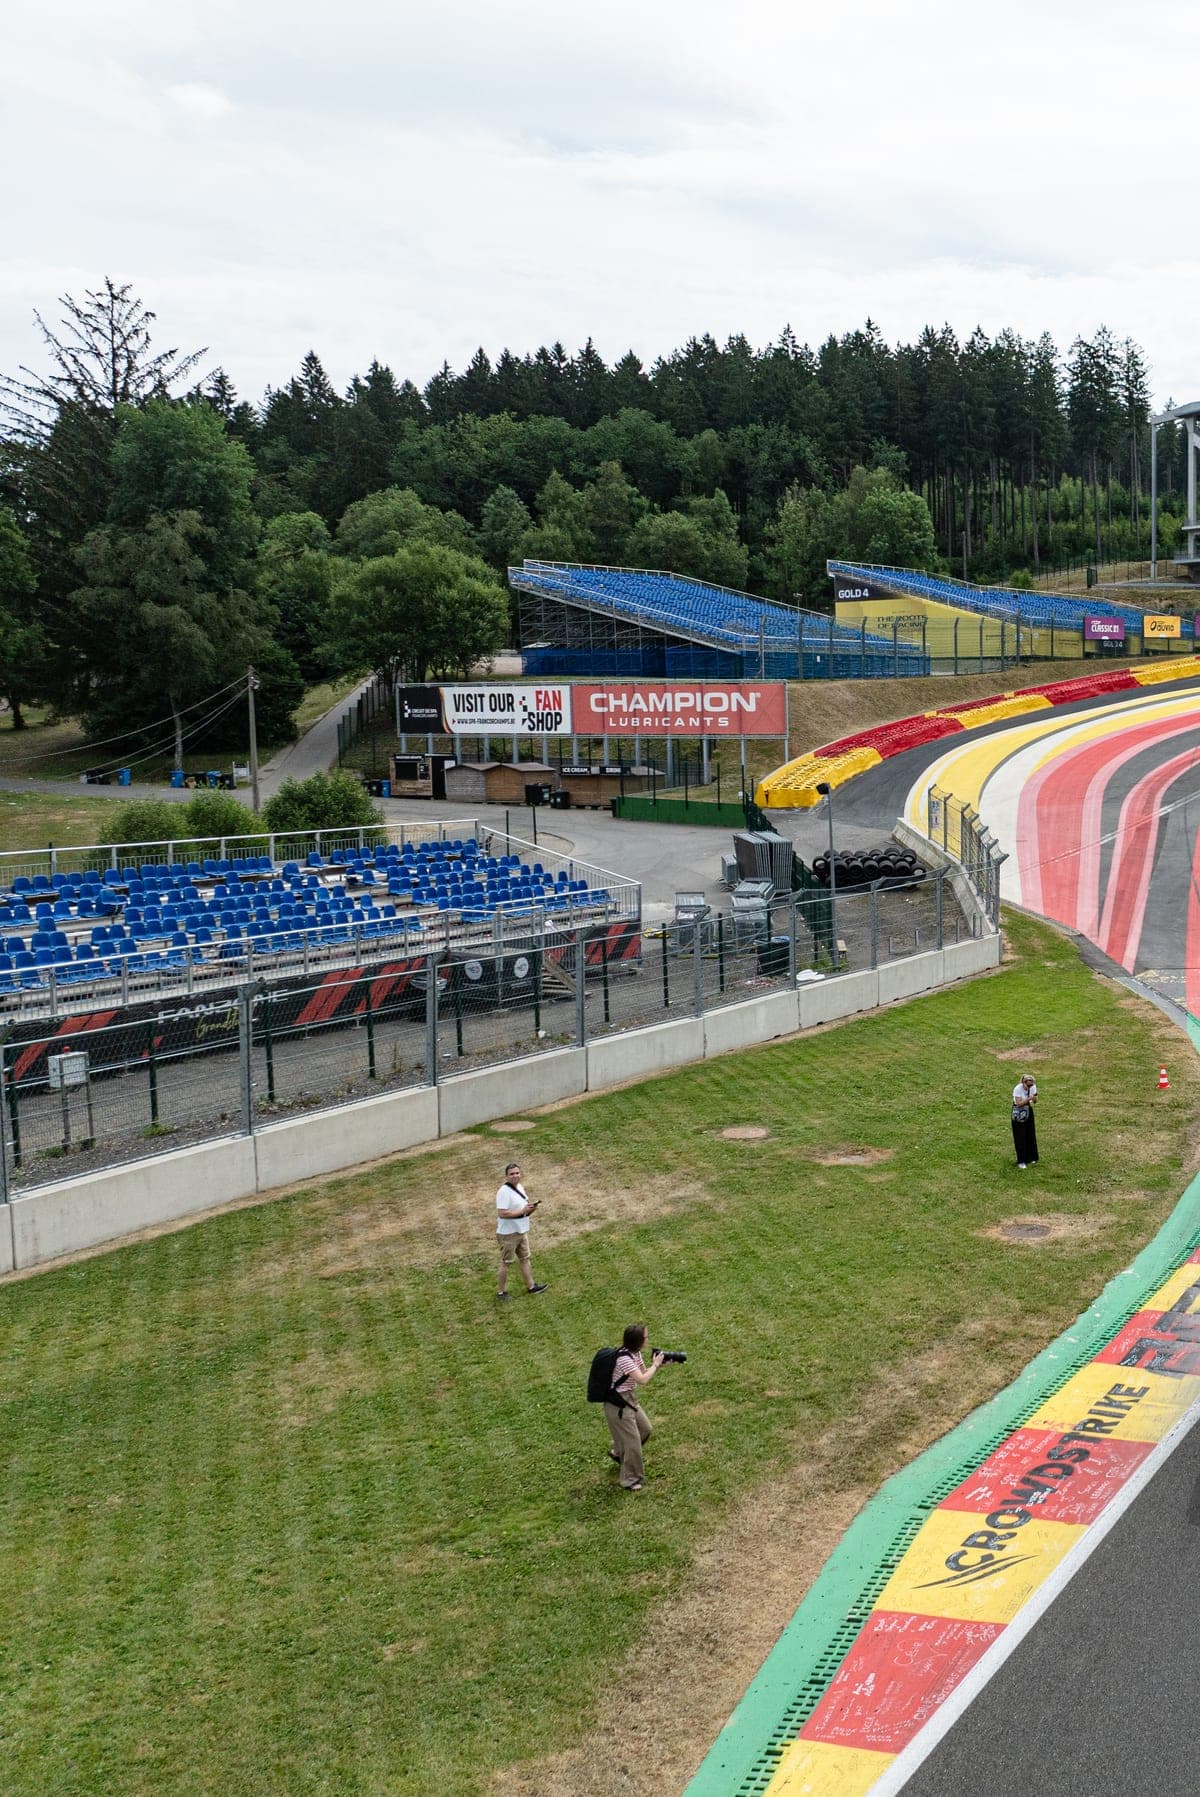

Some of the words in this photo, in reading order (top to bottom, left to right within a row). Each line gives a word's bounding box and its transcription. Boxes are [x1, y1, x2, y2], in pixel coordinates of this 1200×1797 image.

[838, 590, 861, 599] GOLD
[862, 588, 869, 597] 4
[1091, 624, 1112, 633] CLASSIC
[1156, 624, 1175, 632] auvio
[453, 693, 485, 713] VISIT
[489, 693, 515, 713] OUR
[535, 690, 562, 711] FAN
[527, 711, 563, 732] SHOP
[609, 717, 729, 727] LUBRICANTS
[158, 989, 288, 1024] FANZNE
[945, 1383, 1150, 1572] CROWDSTRIKE
